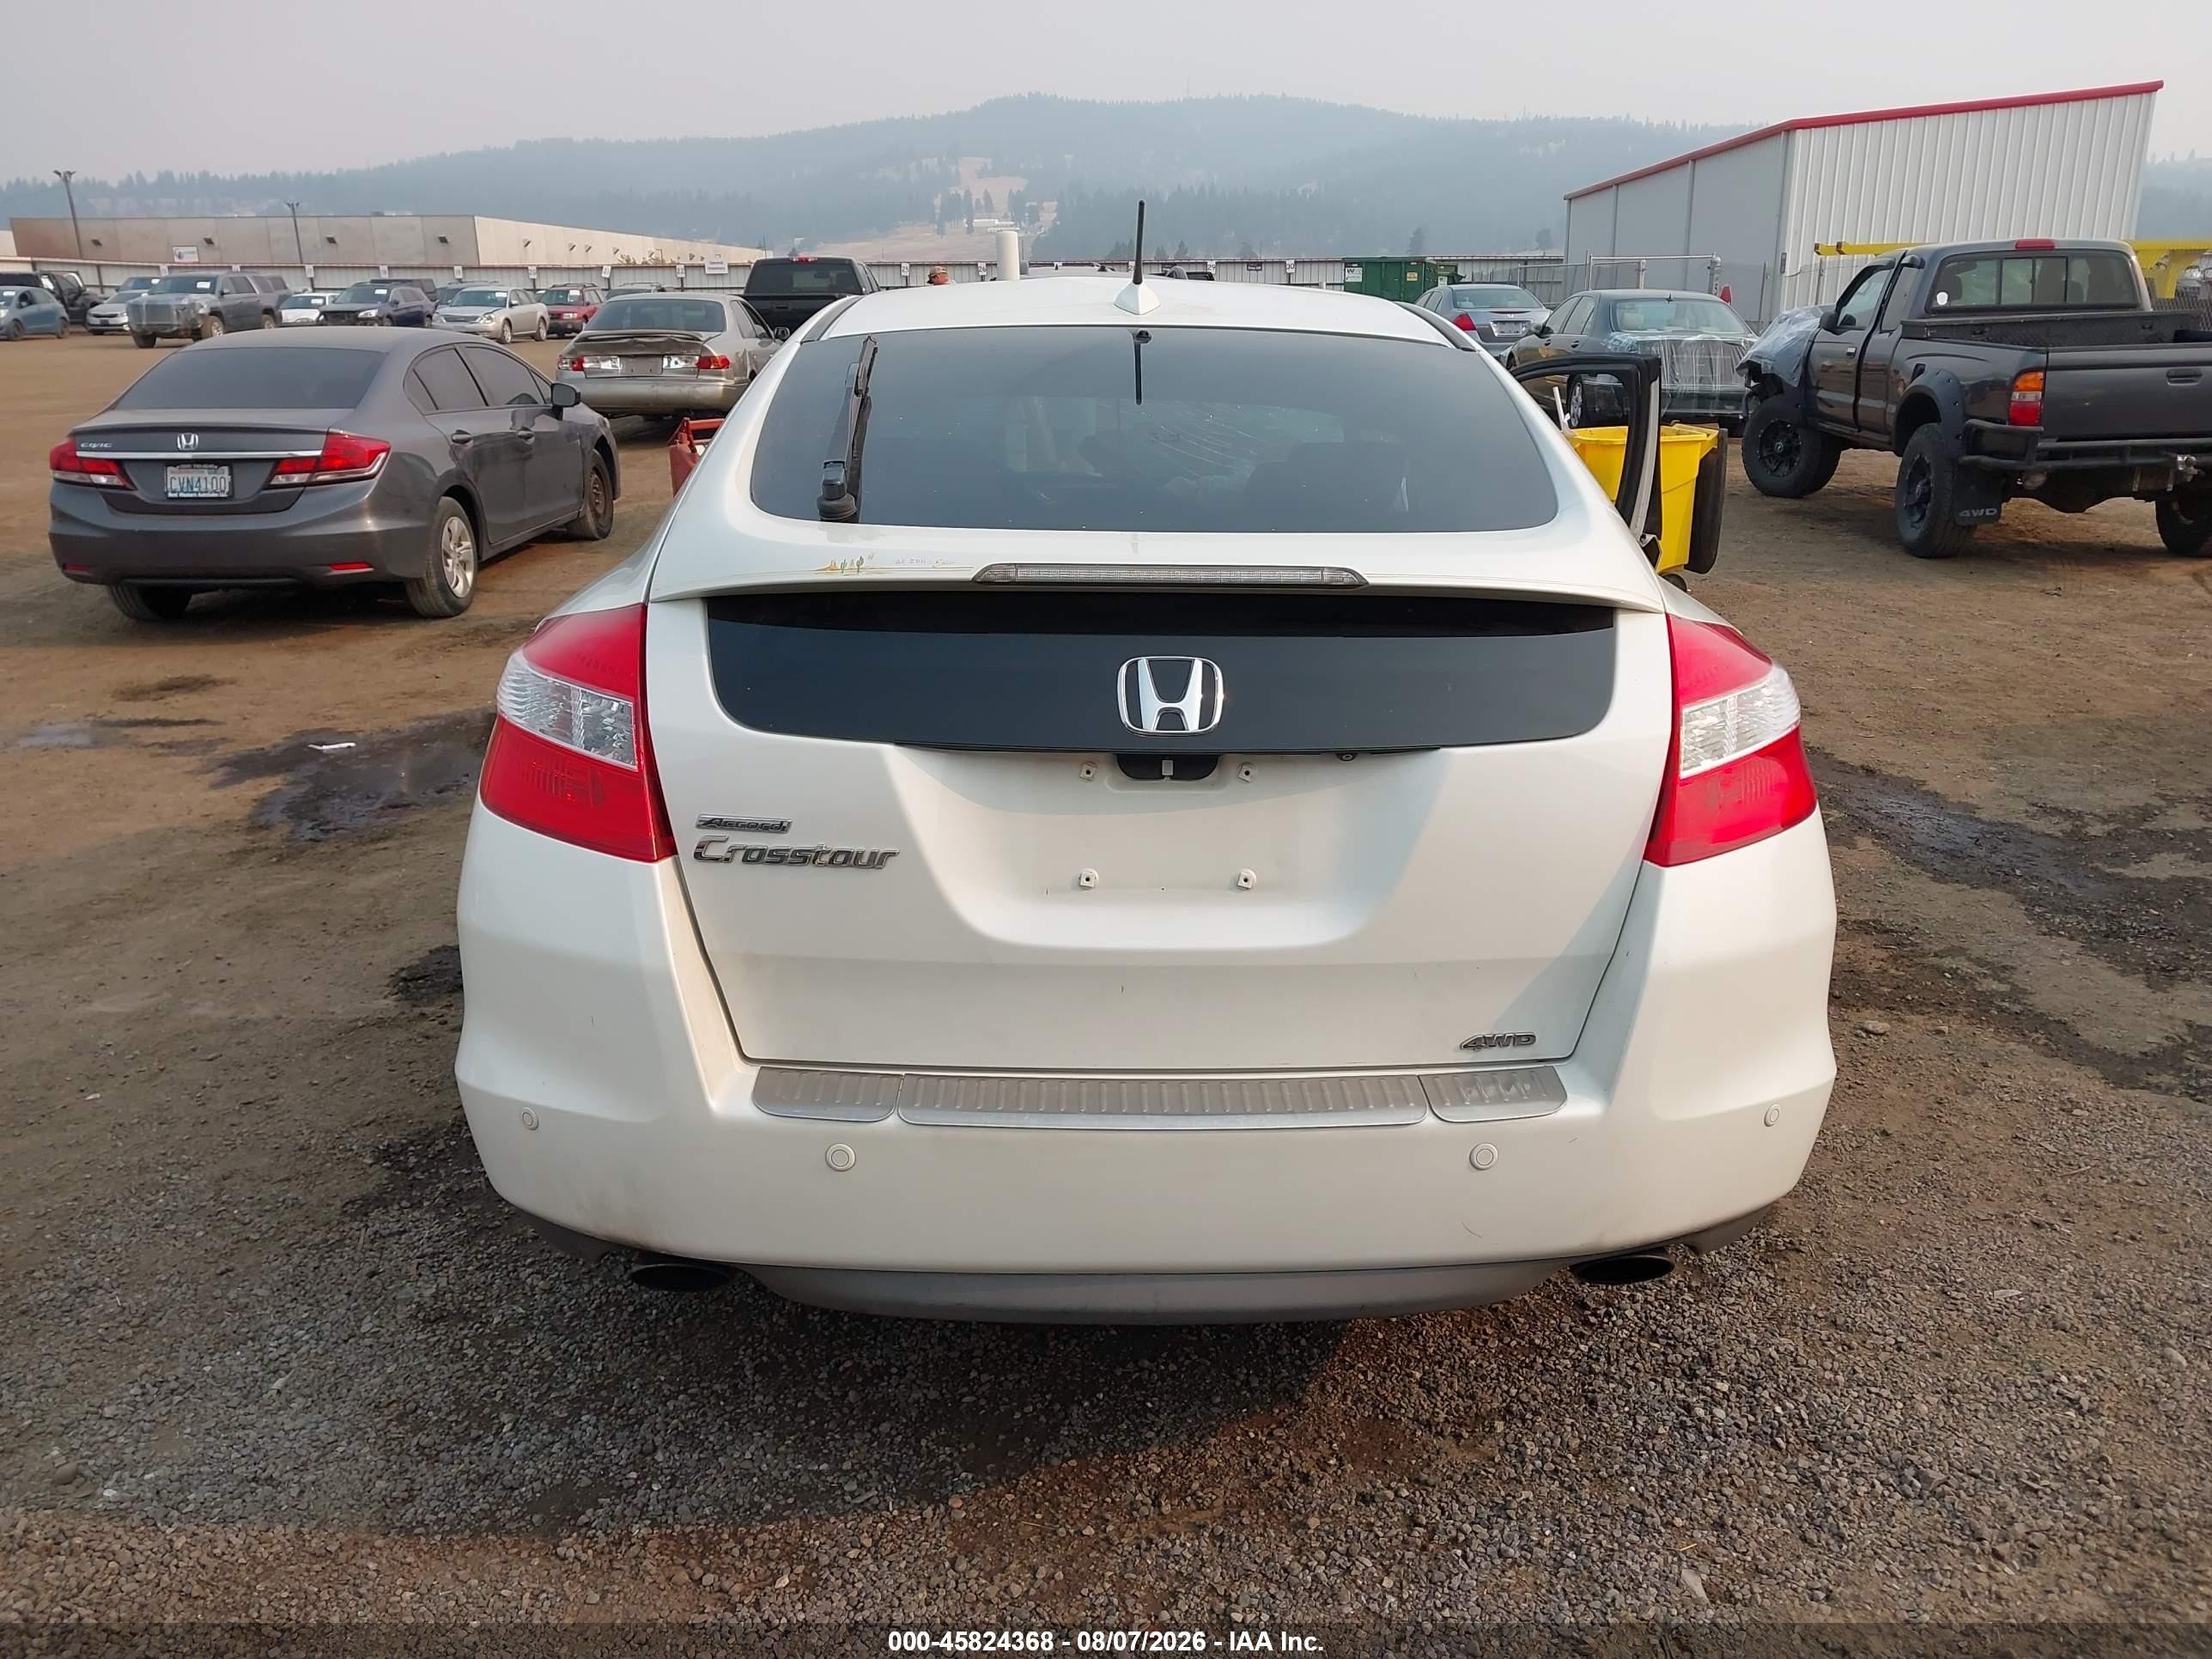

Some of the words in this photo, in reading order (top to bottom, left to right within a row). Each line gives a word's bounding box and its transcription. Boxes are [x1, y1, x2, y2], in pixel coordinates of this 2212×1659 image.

[1959, 507, 1998, 517] 4WD
[697, 815, 793, 834] Accord
[693, 835, 900, 870] Crosstour
[1460, 1031, 1537, 1052] 4WD
